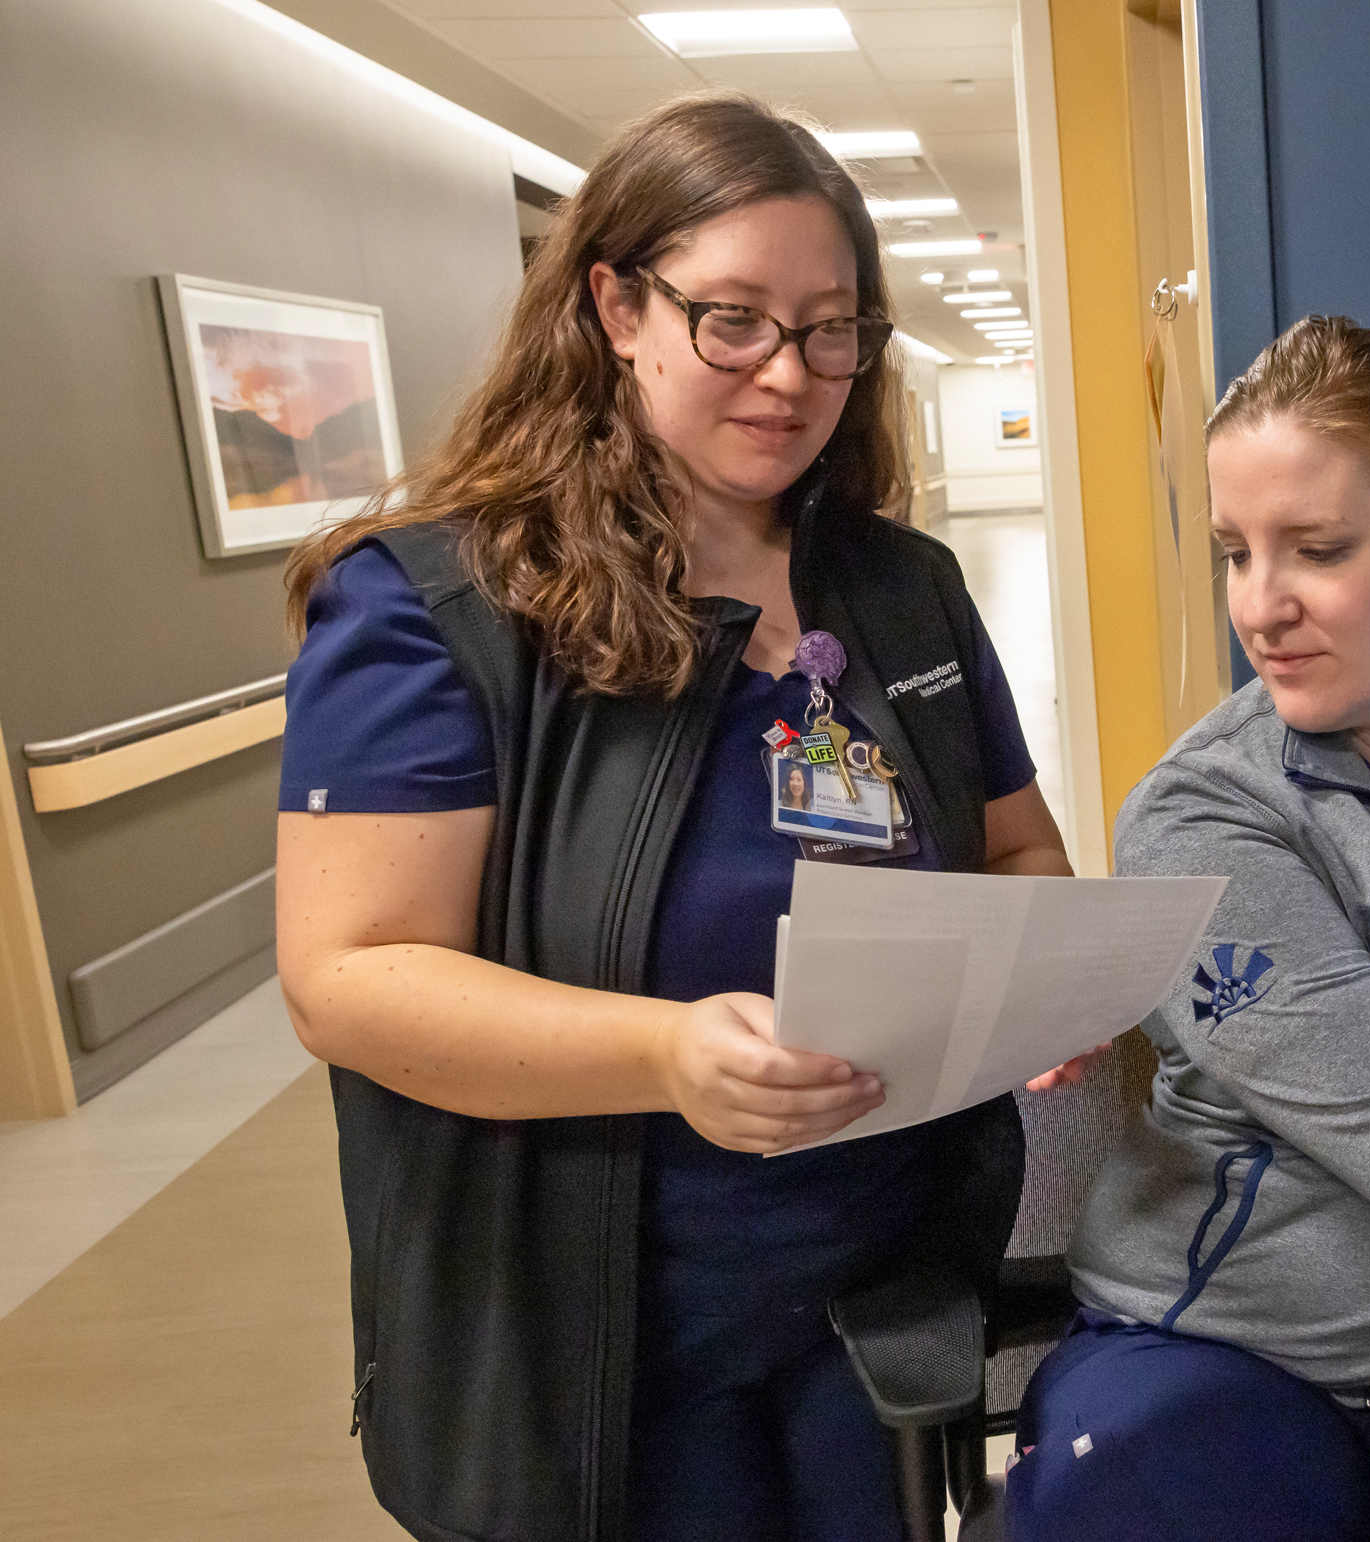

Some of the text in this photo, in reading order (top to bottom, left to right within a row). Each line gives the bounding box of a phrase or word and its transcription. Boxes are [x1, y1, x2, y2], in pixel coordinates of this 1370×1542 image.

[896, 661, 959, 692] Southwestern
[940, 673, 963, 688] Center
[803, 736, 829, 744] DONATE
[808, 748, 835, 761] LIFE
